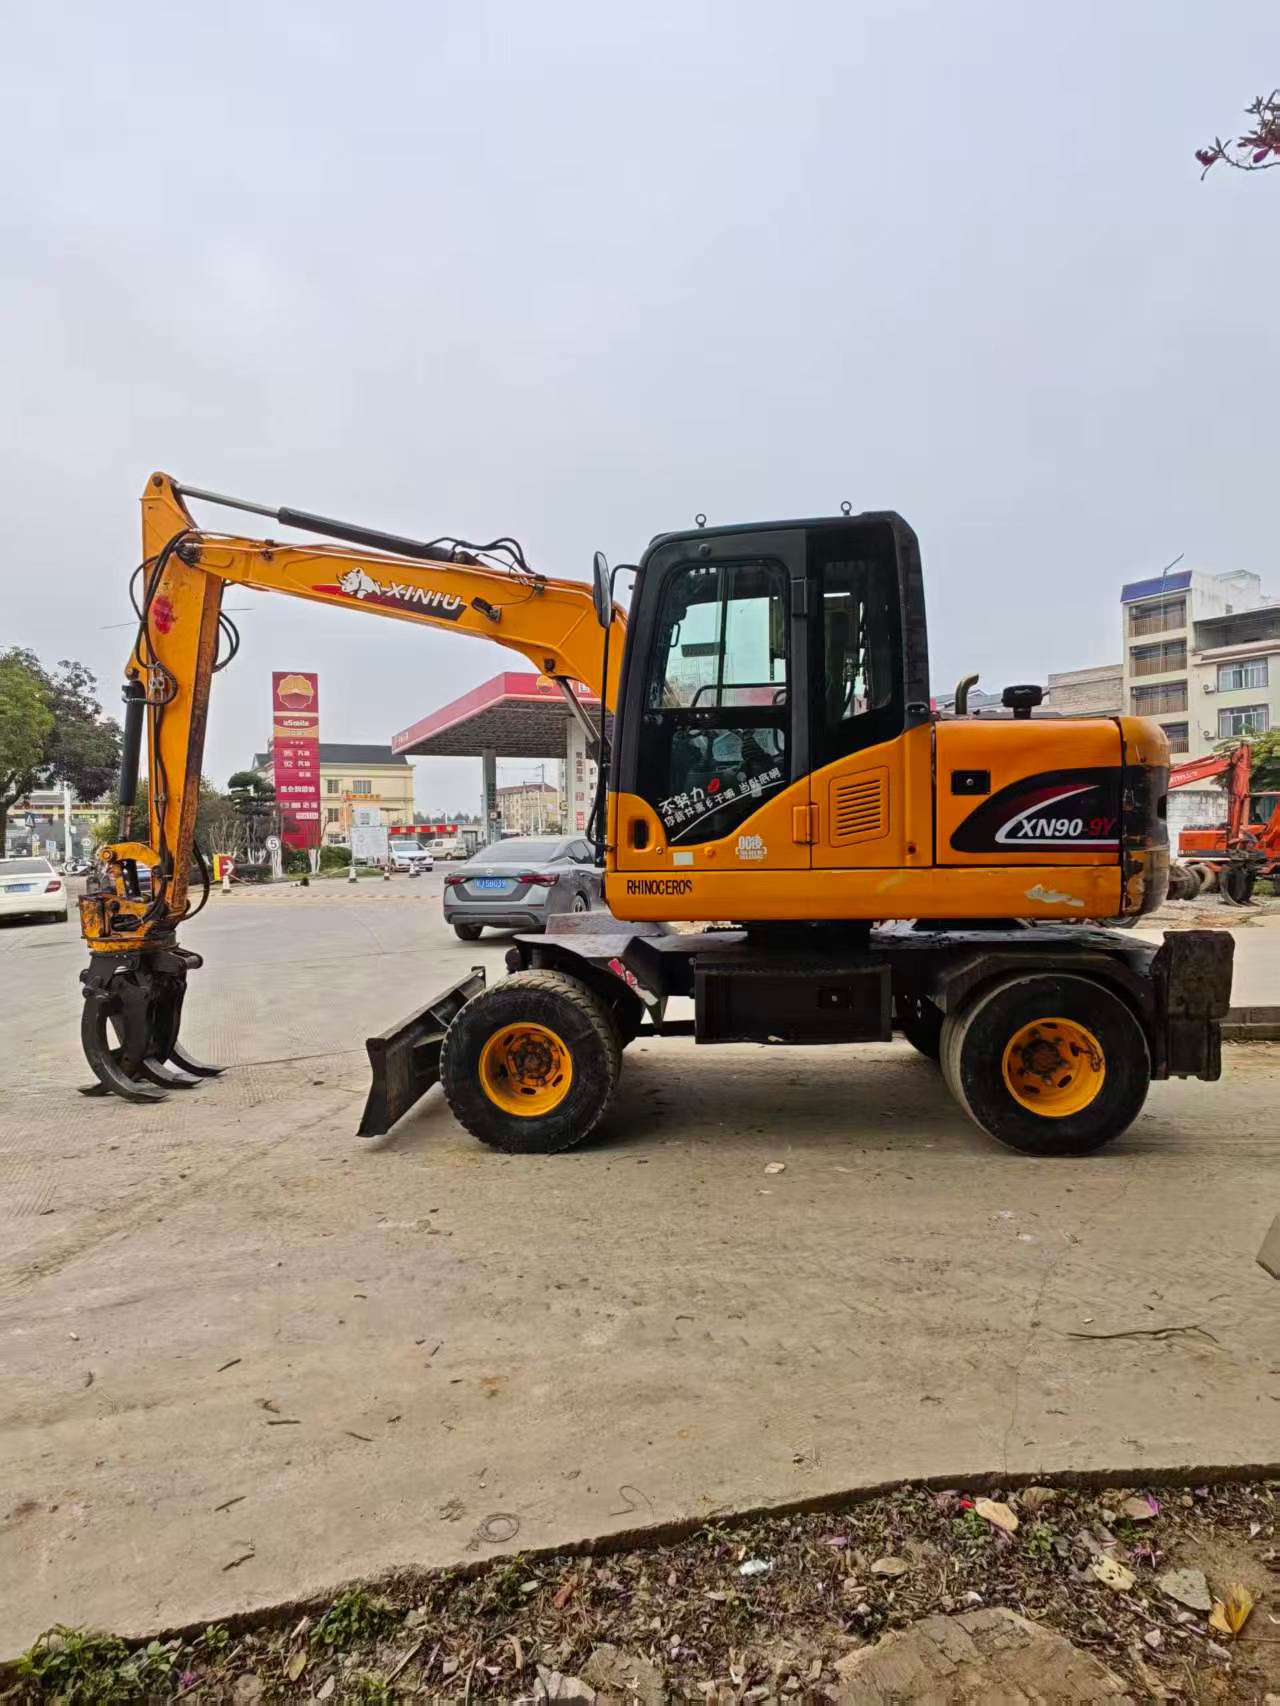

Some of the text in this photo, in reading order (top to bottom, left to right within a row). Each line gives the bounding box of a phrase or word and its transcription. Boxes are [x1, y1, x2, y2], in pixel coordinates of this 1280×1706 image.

[386, 582, 462, 611] XINIU
[659, 787, 705, 815] 不努力
[626, 879, 693, 895] RHINOCEROS
